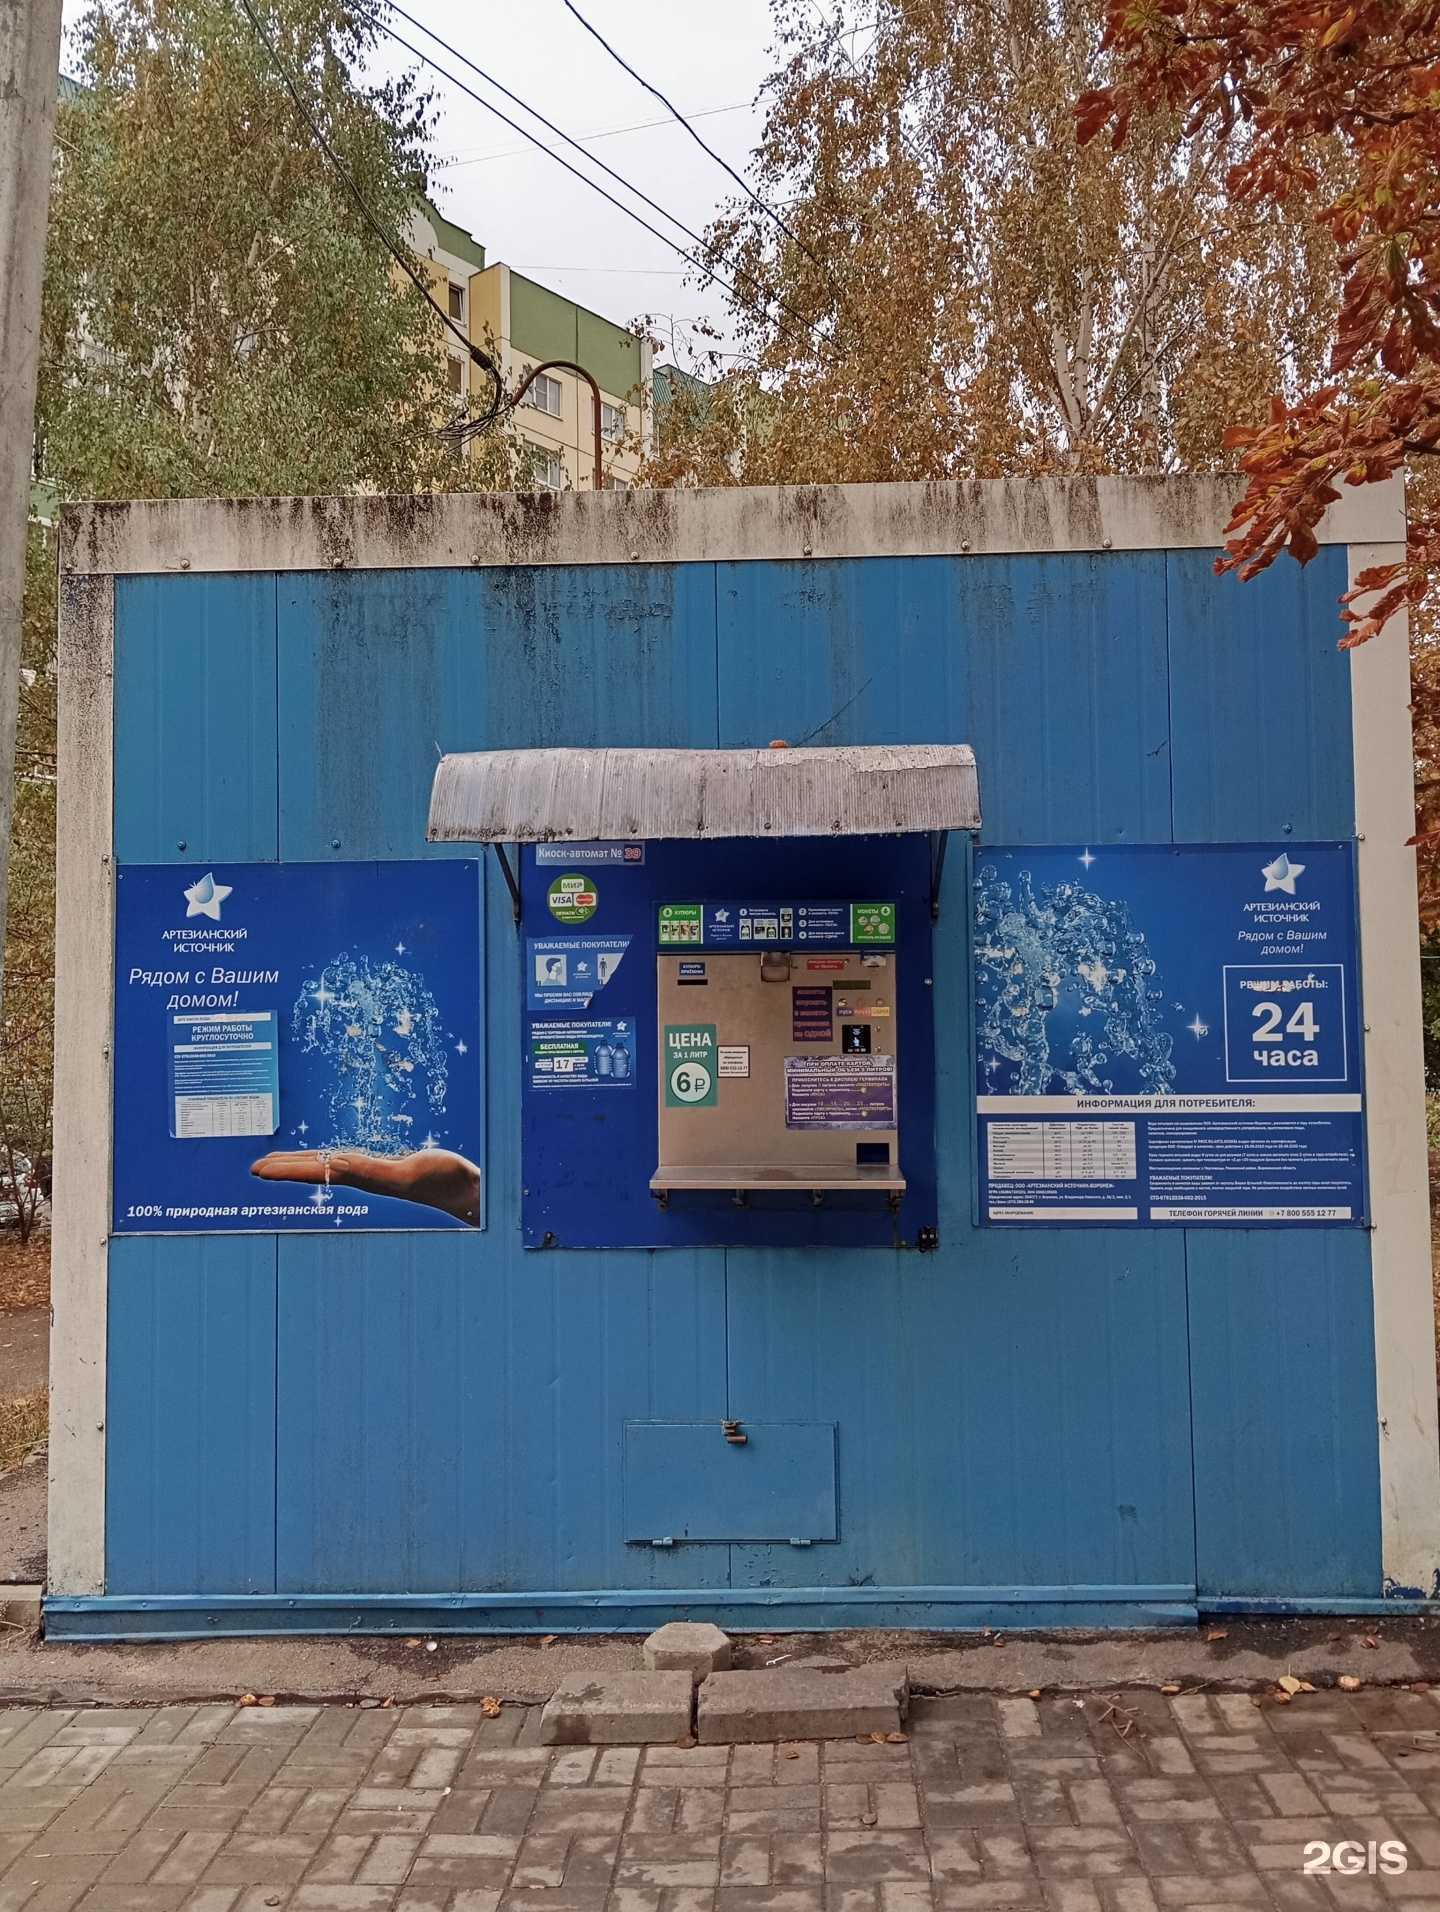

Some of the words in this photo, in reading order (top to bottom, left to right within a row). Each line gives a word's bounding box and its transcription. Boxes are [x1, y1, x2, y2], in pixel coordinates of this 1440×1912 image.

[539, 847, 608, 858] Киоск-автомат
[552, 896, 572, 904] VISA
[1243, 901, 1320, 912] АРТЕЗИАНСКИЙ
[1254, 913, 1310, 923] ИСТОЧНИК
[162, 928, 248, 941] АРТЕЗИАНСКИЙ
[1238, 930, 1274, 941] Рядом
[1277, 932, 1285, 940] с
[1286, 930, 1328, 940] Вашим
[173, 943, 235, 953] ИСТОЧНИК
[534, 942, 581, 950] УВАЖАЕМЫЕ
[1260, 943, 1304, 956] домом!
[129, 968, 190, 987] Рядом
[195, 973, 206, 984] с
[211, 967, 279, 984] Вашим
[166, 991, 239, 1010] домом!
[1252, 1001, 1320, 1042] 24
[192, 1025, 221, 1034] РЕЖИМ
[222, 1024, 253, 1033] РАБОТЫ
[191, 1033, 254, 1042] КРУГЛОСУТОЧНО
[669, 1032, 712, 1050] ЦЕНА
[689, 1050, 708, 1058] ЛИТР
[1253, 1049, 1319, 1066] часа
[555, 1059, 570, 1069] 17
[676, 1072, 691, 1093] 6
[1077, 1099, 1152, 1109] ИНФОРМАЦИЯ
[1154, 1099, 1176, 1108] ДЛЯ
[1178, 1098, 1256, 1108] ПОТРЕБИТЕЛЯ:
[127, 1205, 163, 1217] 100%
[166, 1206, 239, 1219] природная
[240, 1205, 334, 1219] артезианская
[337, 1204, 369, 1217] вода
[1168, 1209, 1203, 1217] ТЕЛЕФОН
[1204, 1208, 1237, 1217] ГОРЯЧЕЙ
